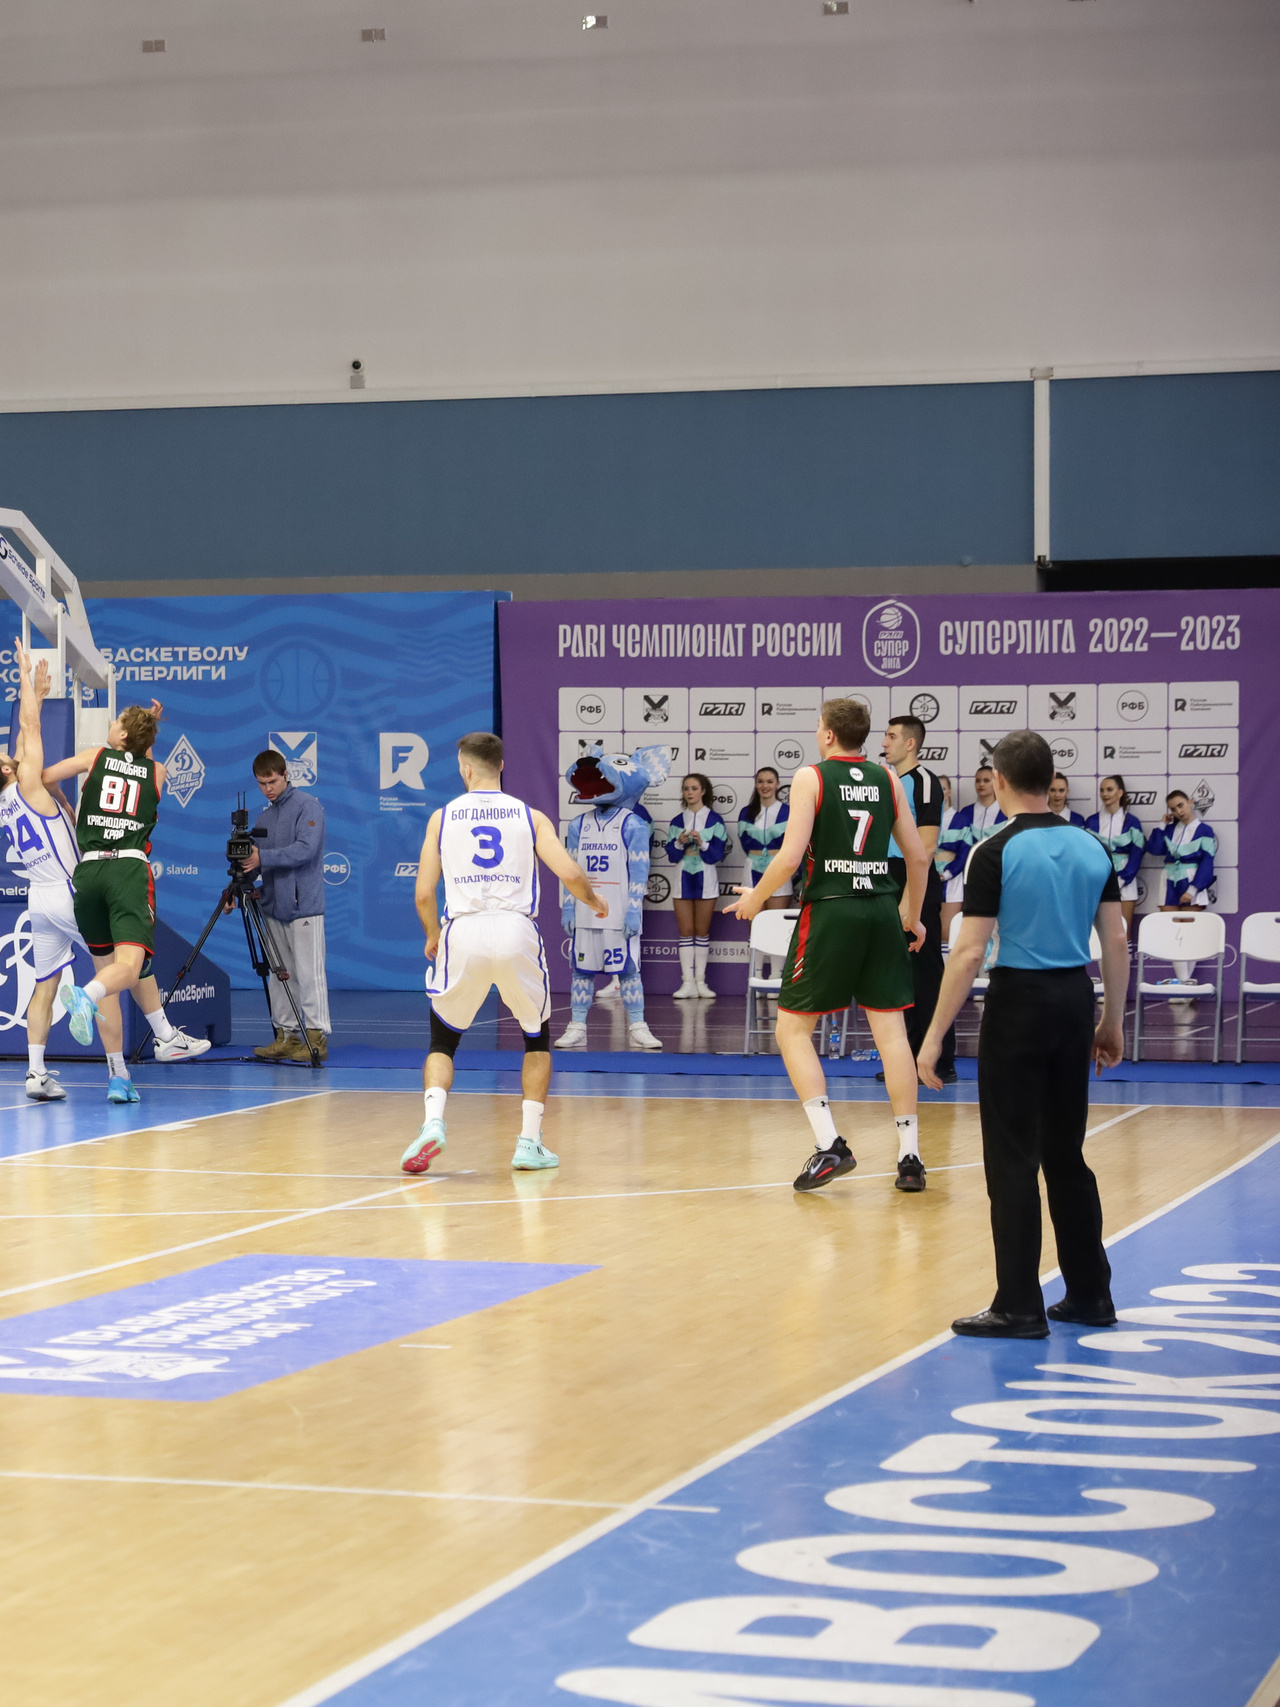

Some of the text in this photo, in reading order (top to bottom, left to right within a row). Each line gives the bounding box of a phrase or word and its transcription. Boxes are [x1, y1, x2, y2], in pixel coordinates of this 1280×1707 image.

[558, 622, 842, 658] PARI ЧЕМПИОНАТ РОССИИ
[938, 618, 1076, 656] СУПЕРЛИГА
[100, 646, 249, 662] БАСКЕТБОЛУ
[873, 639, 909, 657] СУПЕР
[881, 657, 901, 670] ЛИГА
[114, 665, 227, 682] УПЕРЛИГИ
[580, 705, 602, 714] РФБ
[700, 703, 745, 716] PARI
[970, 701, 1016, 714] PARI
[1121, 701, 1145, 711] РФБ
[778, 750, 800, 759] РФБ
[918, 747, 948, 760] ARI
[1179, 744, 1228, 757] PARI
[104, 756, 148, 779] ТЮЛЮБАЕВ
[99, 775, 141, 817] 81
[838, 784, 880, 803] ТЕМИРОВ
[1125, 792, 1156, 805] ARI
[451, 807, 521, 822] БОГДАНОВИЧ
[847, 809, 874, 856] 7
[470, 825, 505, 869] 3
[581, 843, 618, 851] ДИНАМО
[166, 864, 198, 875] slavda
[323, 863, 347, 873] РФБ
[586, 855, 609, 872] 125
[453, 873, 521, 885] ВЛАДИВОСТОК
[603, 948, 624, 965] 25
[641, 946, 678, 955] ЕТБОЛ
